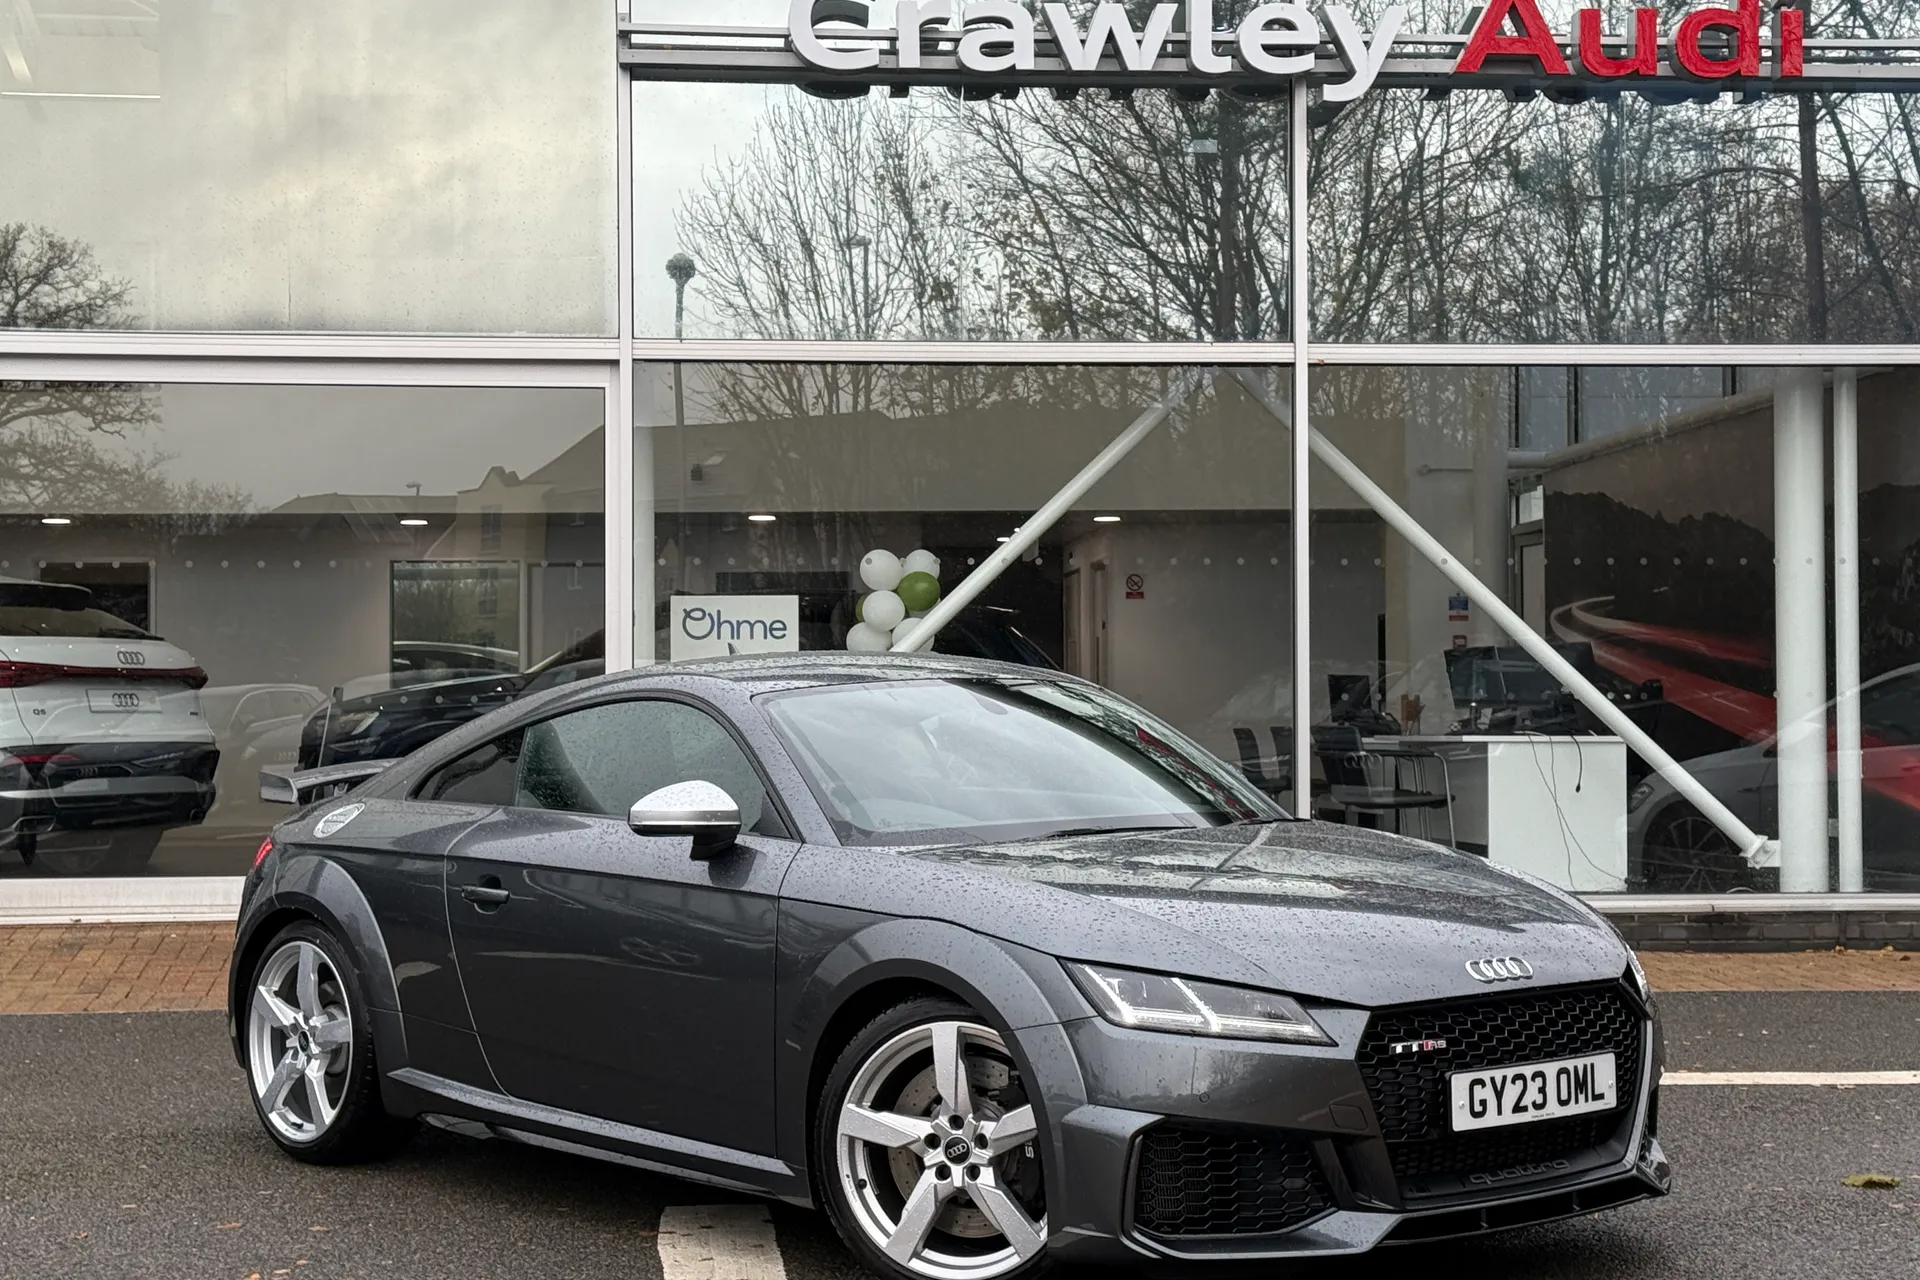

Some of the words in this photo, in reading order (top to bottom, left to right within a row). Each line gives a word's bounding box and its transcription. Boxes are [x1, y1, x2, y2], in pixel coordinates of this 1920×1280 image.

[788, 0, 1404, 102] Crawley
[1450, 0, 1804, 79] Audi
[682, 607, 787, 640] Ohme
[1468, 1070, 1547, 1119] GY23
[1556, 1062, 1605, 1108] OML
[1469, 1159, 1571, 1185] quattro
